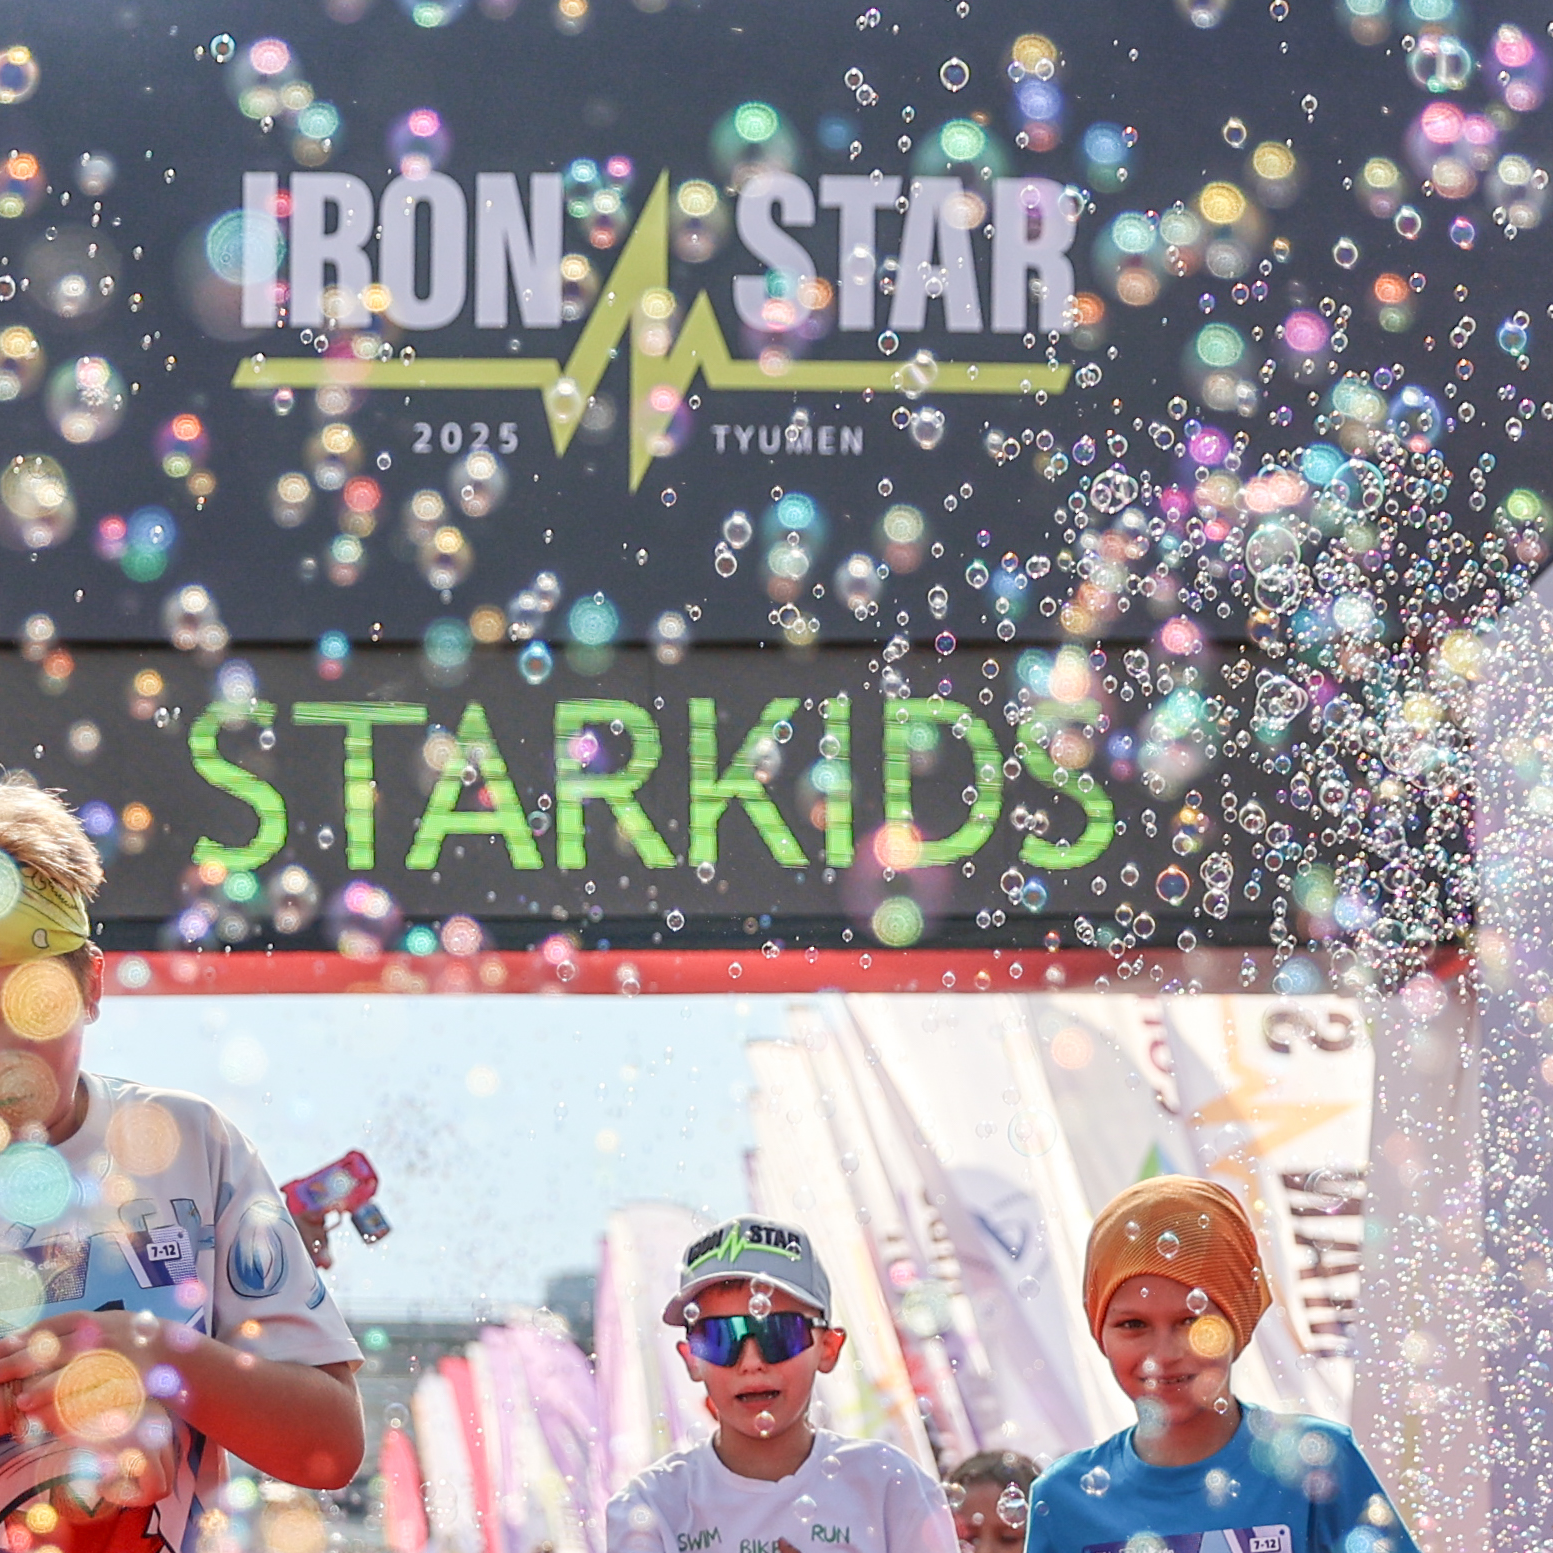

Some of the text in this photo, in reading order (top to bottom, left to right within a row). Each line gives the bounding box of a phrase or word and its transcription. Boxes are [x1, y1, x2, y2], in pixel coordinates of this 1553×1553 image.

[241, 170, 1076, 335] IRON STAR
[413, 421, 865, 456] 2025 TYUMEN
[187, 698, 1116, 870] STARKIDS
[150, 1243, 176, 1258] 7-12
[750, 1224, 801, 1256] STAR
[677, 1527, 722, 1551] SWIM
[811, 1524, 850, 1544] RUN
[1254, 1539, 1277, 1551] 7-12
